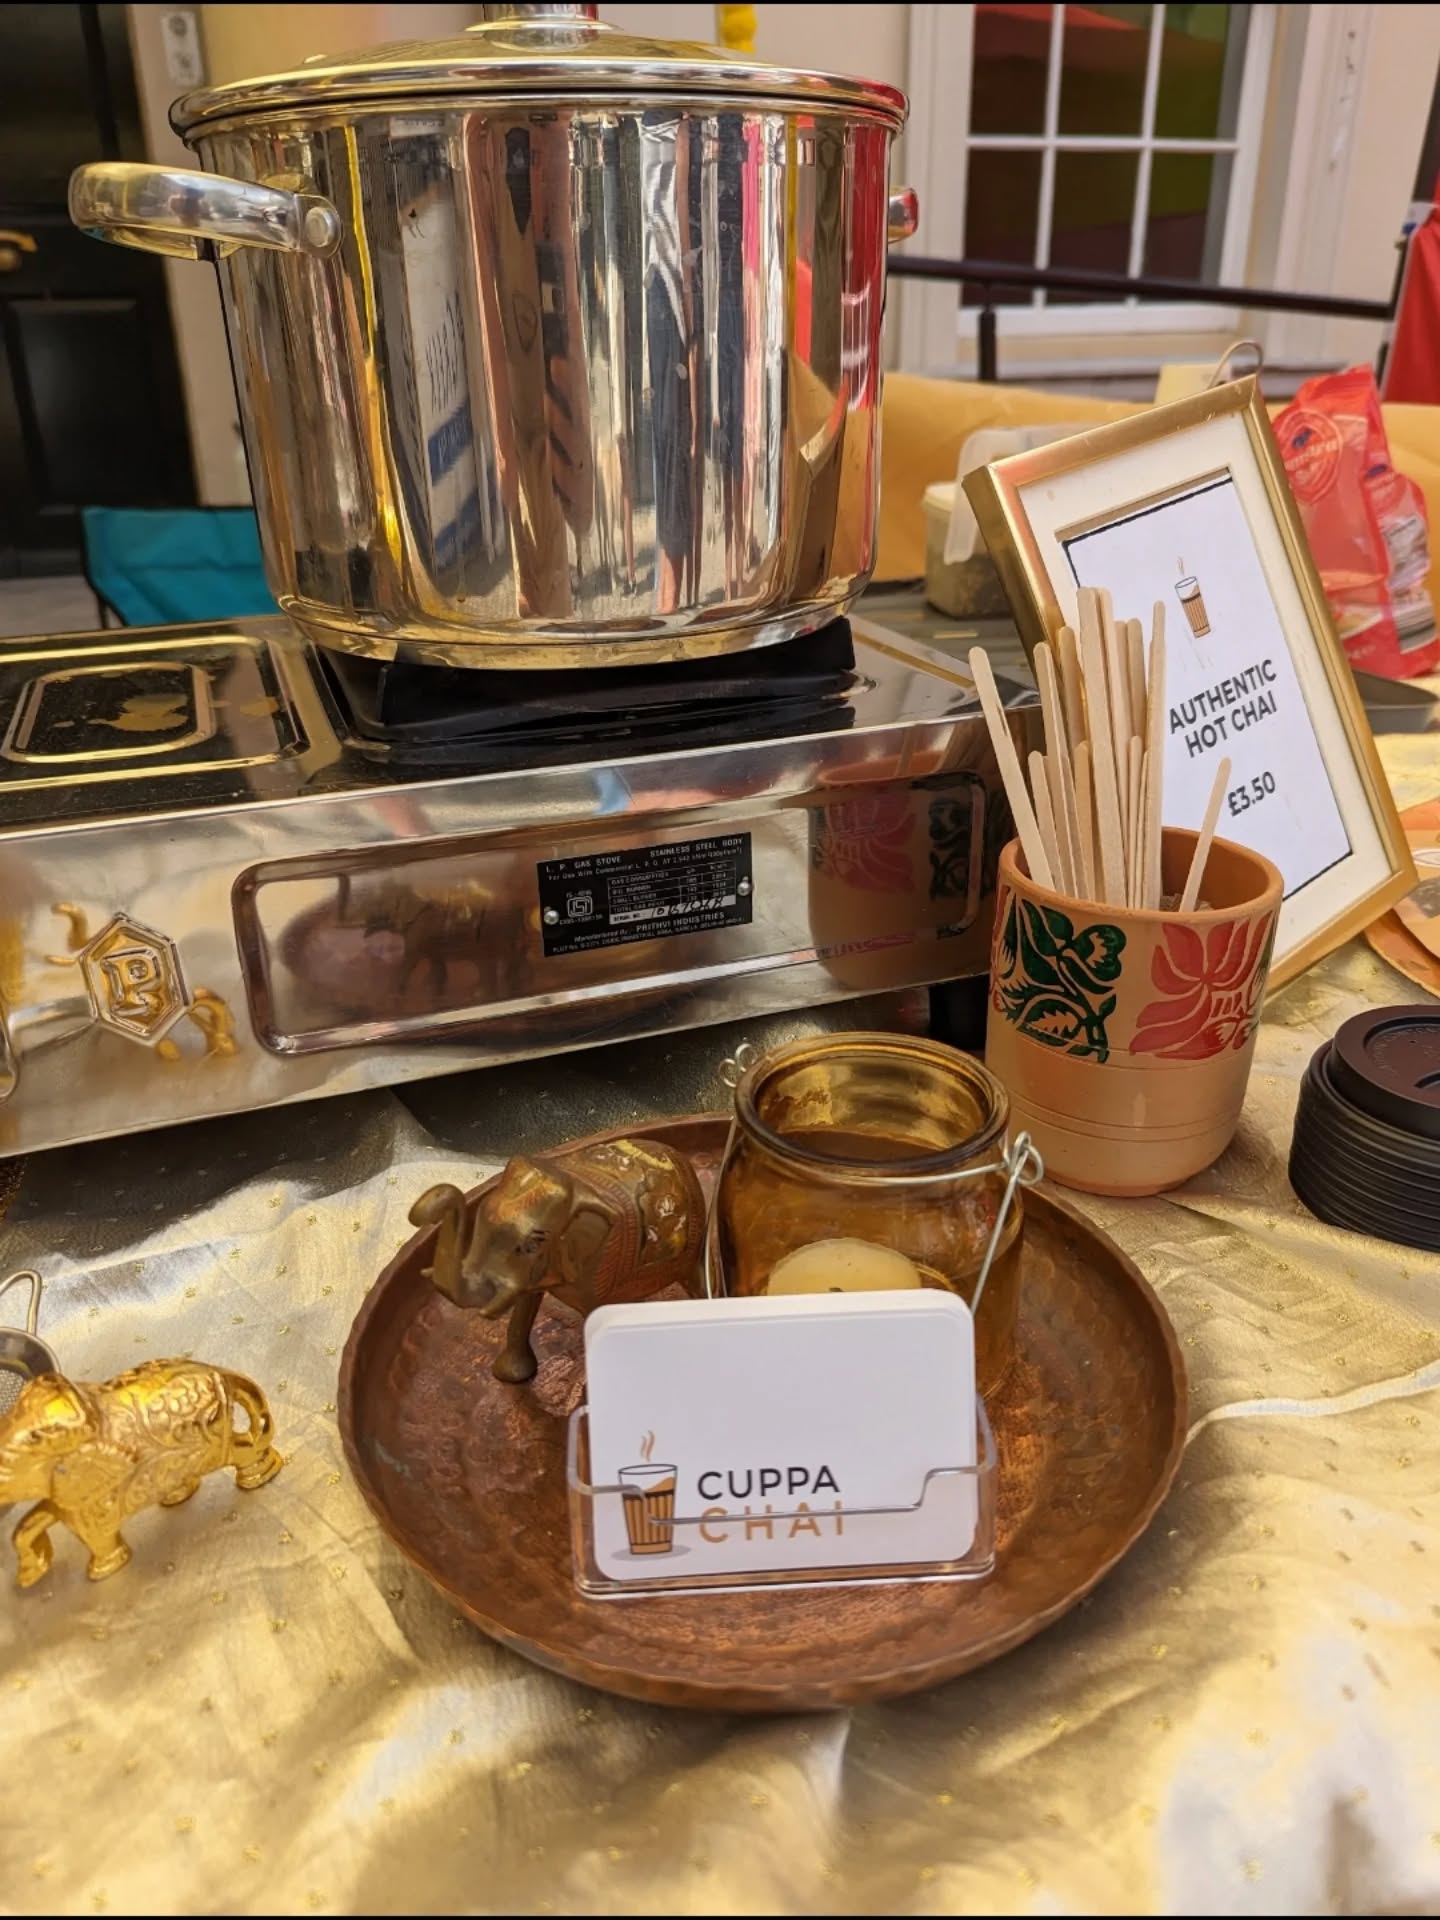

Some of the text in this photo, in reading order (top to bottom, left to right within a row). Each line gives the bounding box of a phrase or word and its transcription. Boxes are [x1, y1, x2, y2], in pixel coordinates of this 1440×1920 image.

[1168, 659, 1277, 735] AUTHENTIC
[1184, 692, 1278, 759] HOT CHAI
[1227, 771, 1277, 817] £3.50
[574, 860, 591, 869] GAS
[596, 856, 621, 867] STOVE
[673, 911, 725, 926] INDUSTRIES
[697, 1464, 841, 1502] CUPPA
[698, 1500, 846, 1544] CHAI
